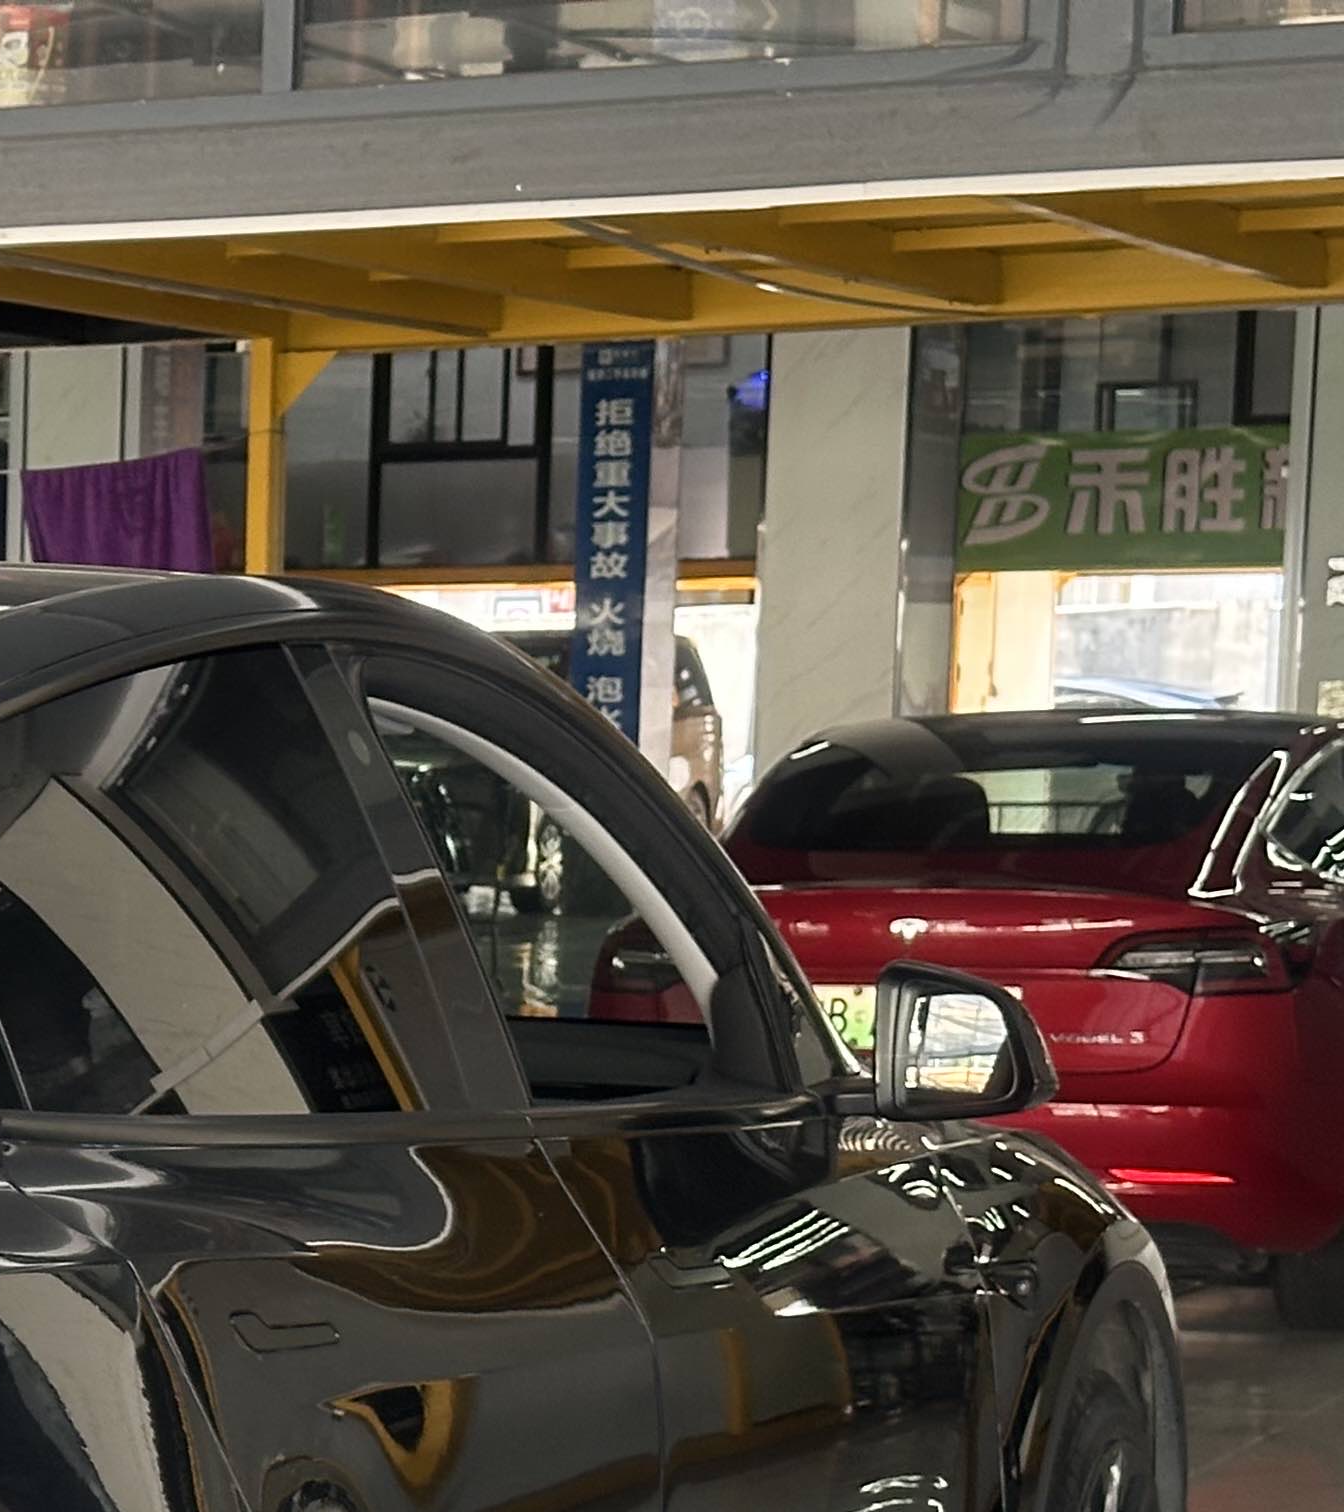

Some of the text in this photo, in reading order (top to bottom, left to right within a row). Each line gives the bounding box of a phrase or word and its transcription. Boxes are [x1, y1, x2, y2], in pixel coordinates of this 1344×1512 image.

[589, 398, 634, 579] 拒绝重大事故
[587, 598, 626, 657] 火烧
[1129, 1030, 1145, 1044] 3
